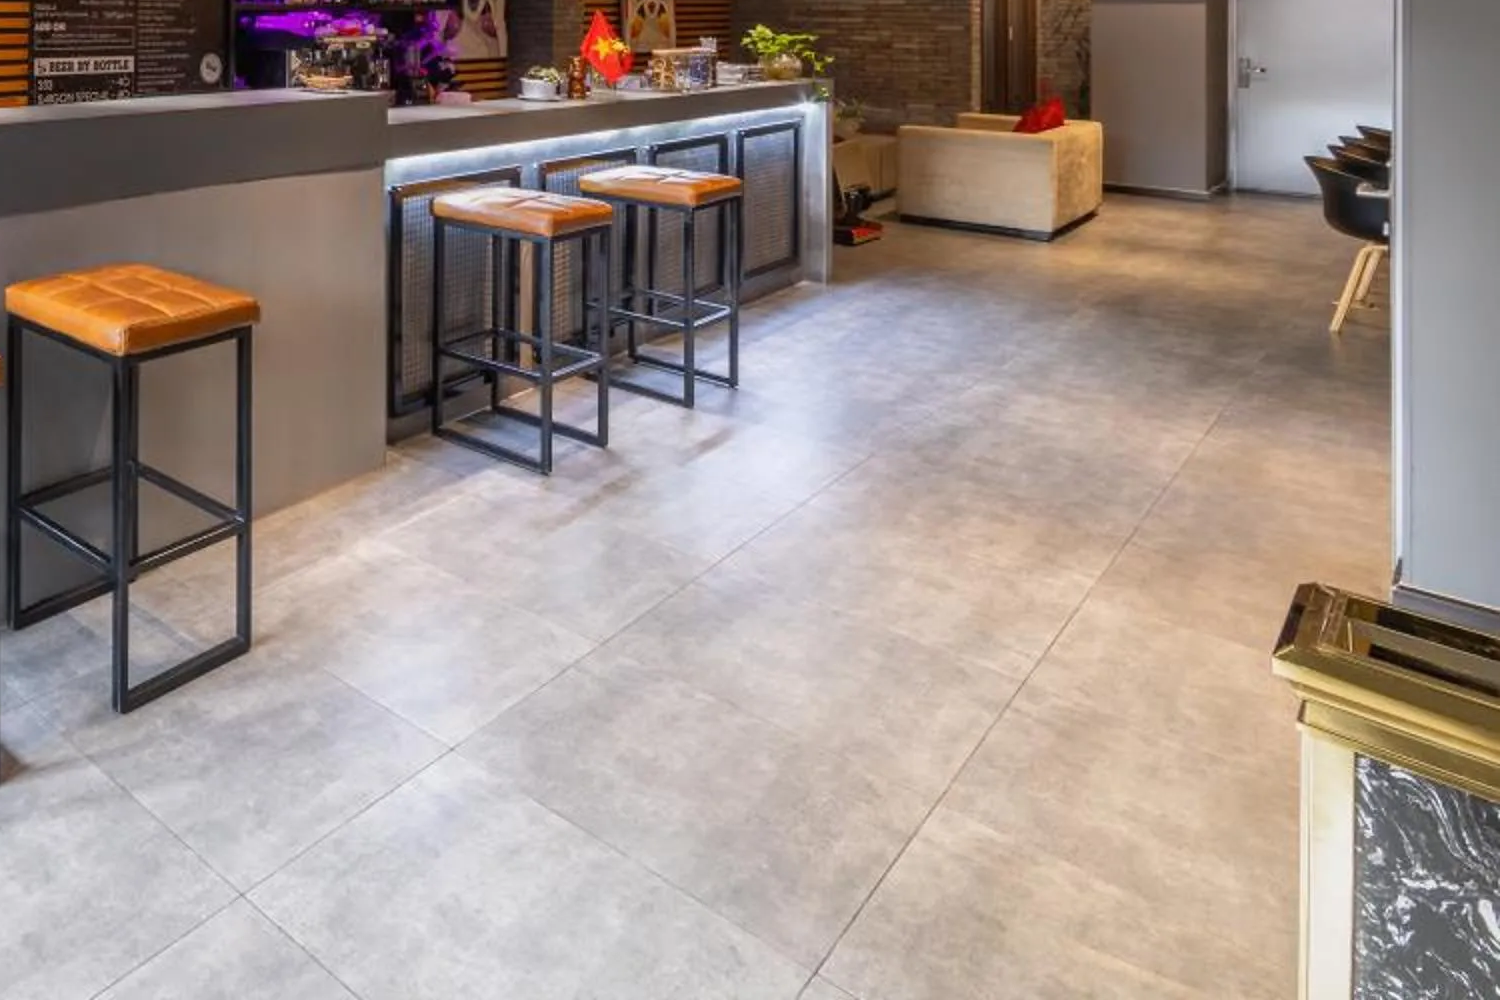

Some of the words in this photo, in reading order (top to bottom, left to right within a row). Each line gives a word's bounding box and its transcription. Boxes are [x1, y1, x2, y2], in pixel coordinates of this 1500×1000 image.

[49, 61, 75, 73] BEER
[77, 60, 91, 72] BY
[93, 59, 130, 72] BOTTLE
